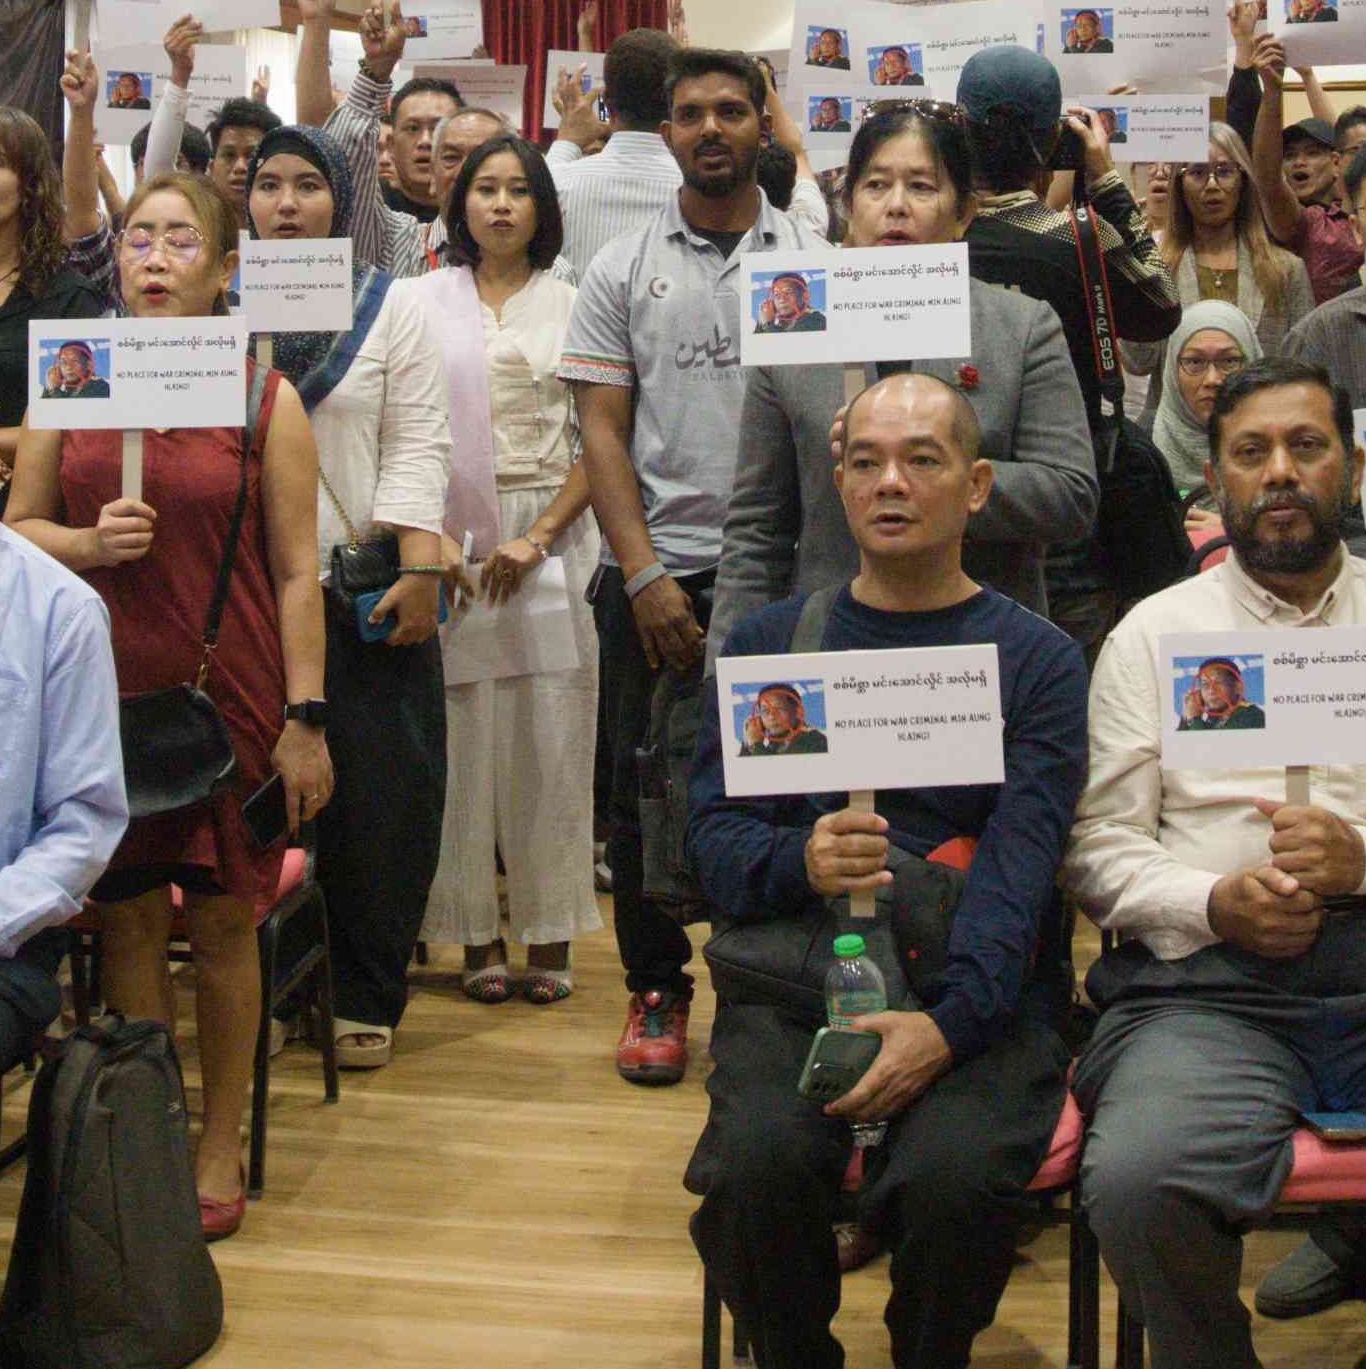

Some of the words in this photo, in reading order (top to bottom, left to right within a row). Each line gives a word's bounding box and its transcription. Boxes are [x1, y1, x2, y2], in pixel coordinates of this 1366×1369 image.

[1096, 317, 1108, 335] 7D
[1100, 336, 1115, 370] EOS
[1274, 695, 1283, 705] NO
[1328, 693, 1345, 703] WAR
[835, 720, 845, 729] NO
[890, 717, 908, 727] WAR
